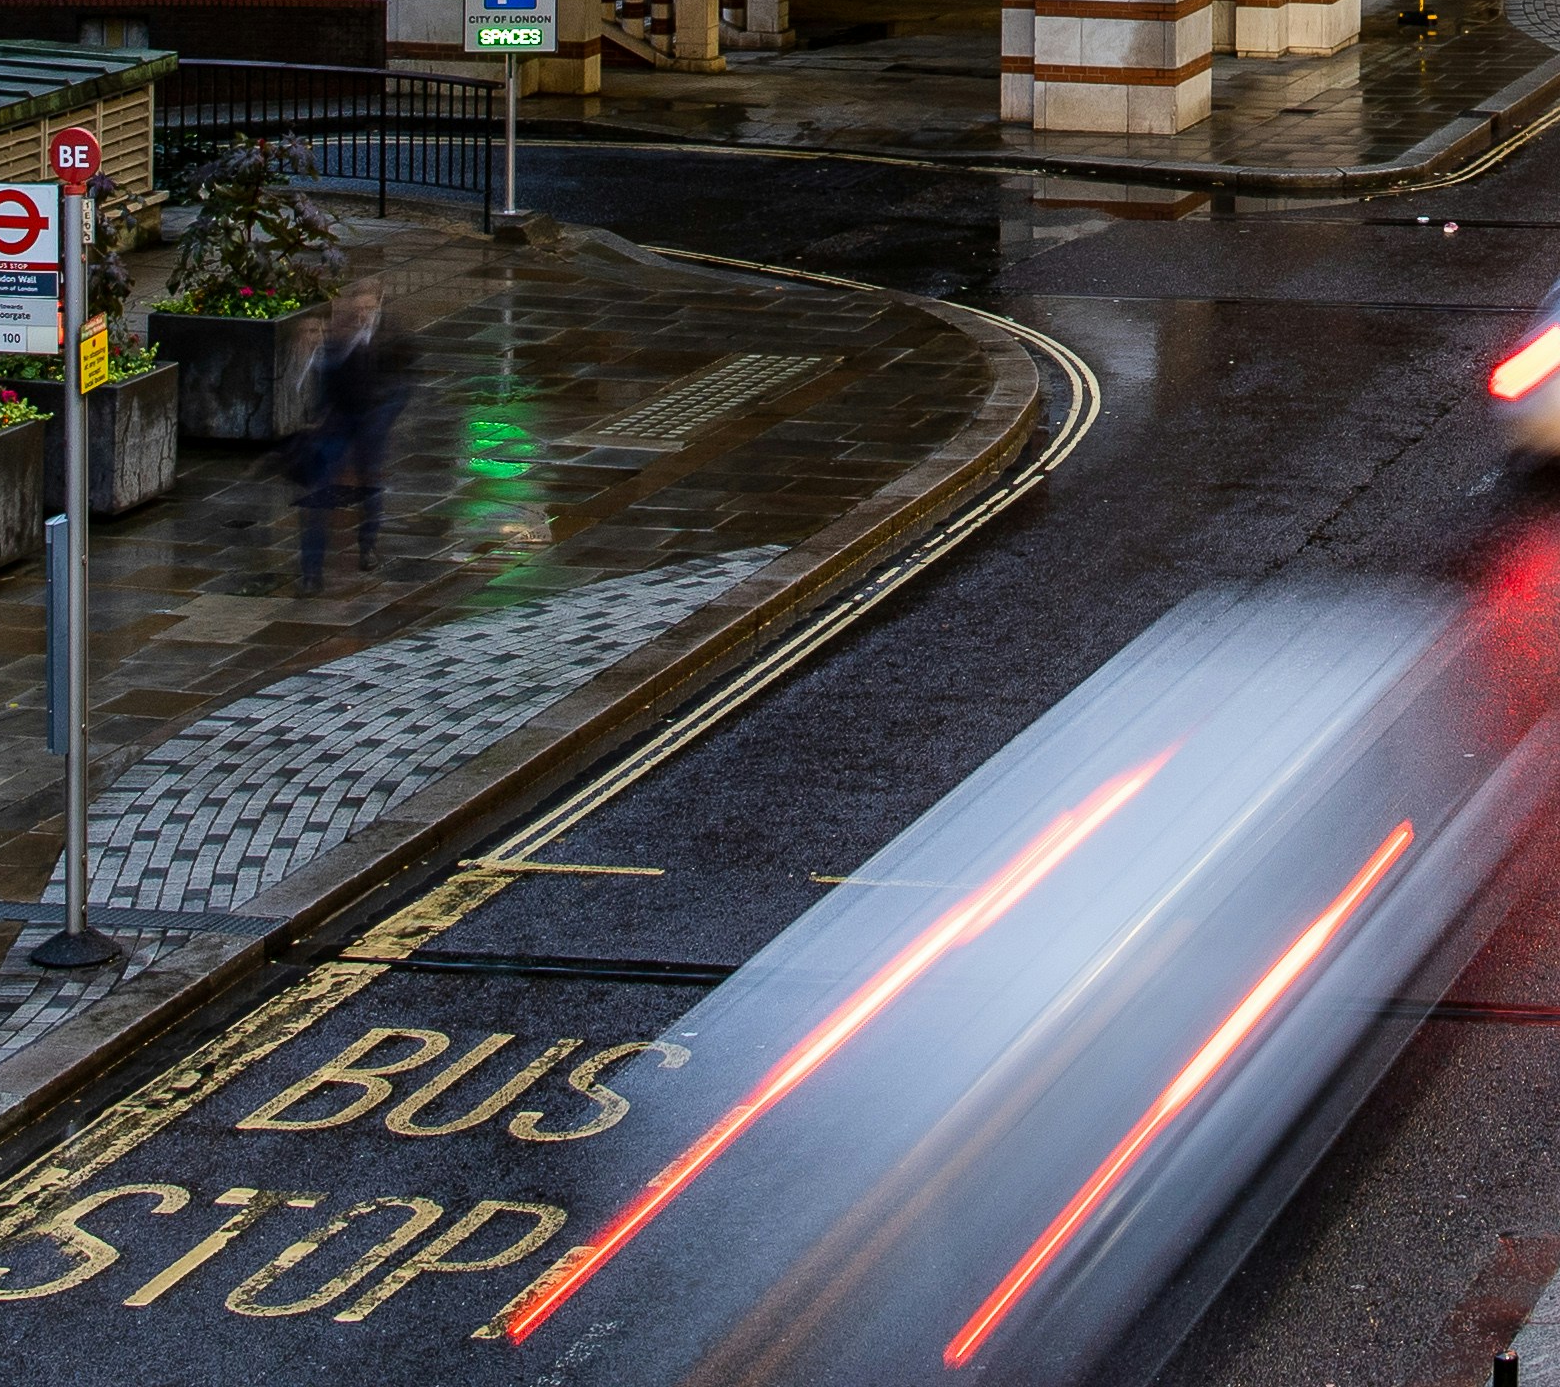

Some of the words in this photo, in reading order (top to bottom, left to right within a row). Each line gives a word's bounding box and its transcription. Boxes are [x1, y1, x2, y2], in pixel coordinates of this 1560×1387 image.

[468, 15, 491, 24] CITY
[493, 16, 507, 24] OF
[509, 16, 552, 24] LONDON
[479, 28, 542, 45] SPACES
[58, 145, 90, 168] BE
[18, 275, 37, 283] Wall
[2, 333, 21, 343] 100
[237, 1027, 692, 1142] BUS
